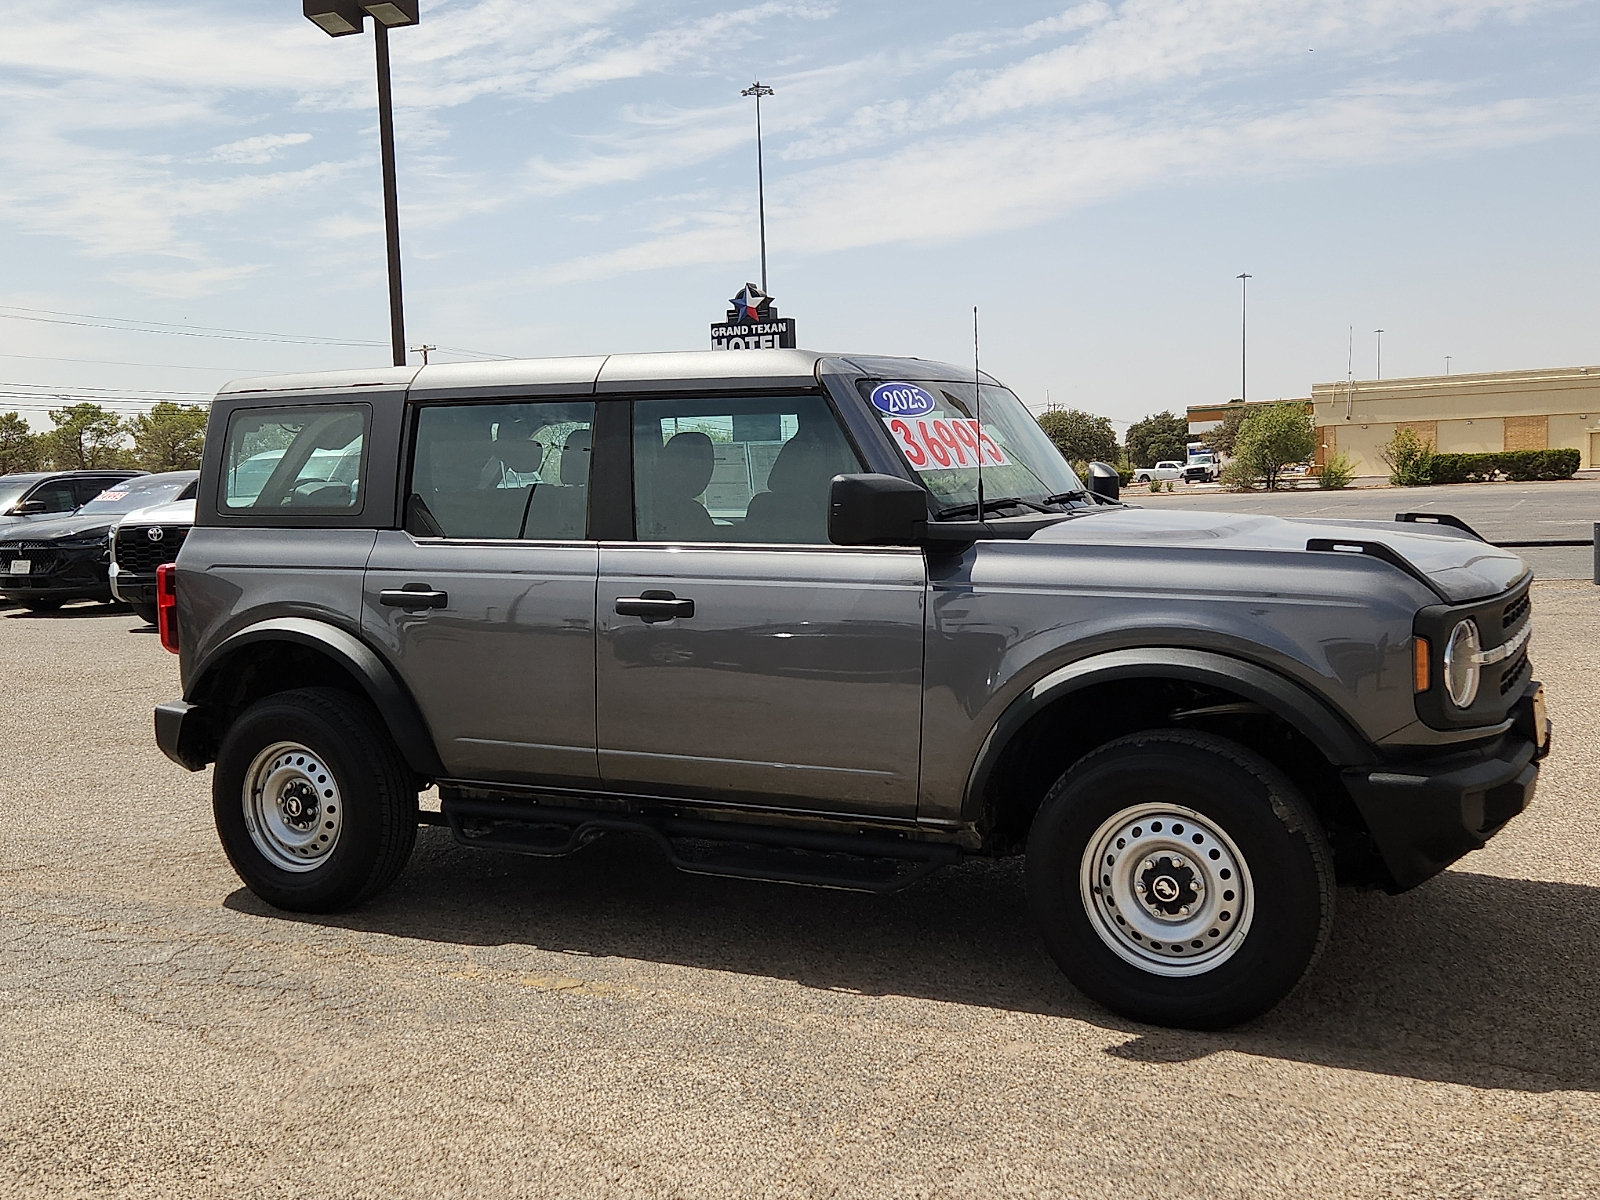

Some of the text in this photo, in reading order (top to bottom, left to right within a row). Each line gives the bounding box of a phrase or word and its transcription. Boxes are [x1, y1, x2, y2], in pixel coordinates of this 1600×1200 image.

[711, 322, 787, 337] GRAND TEXAN
[882, 389, 927, 412] 2025
[890, 419, 1004, 467] 36995
